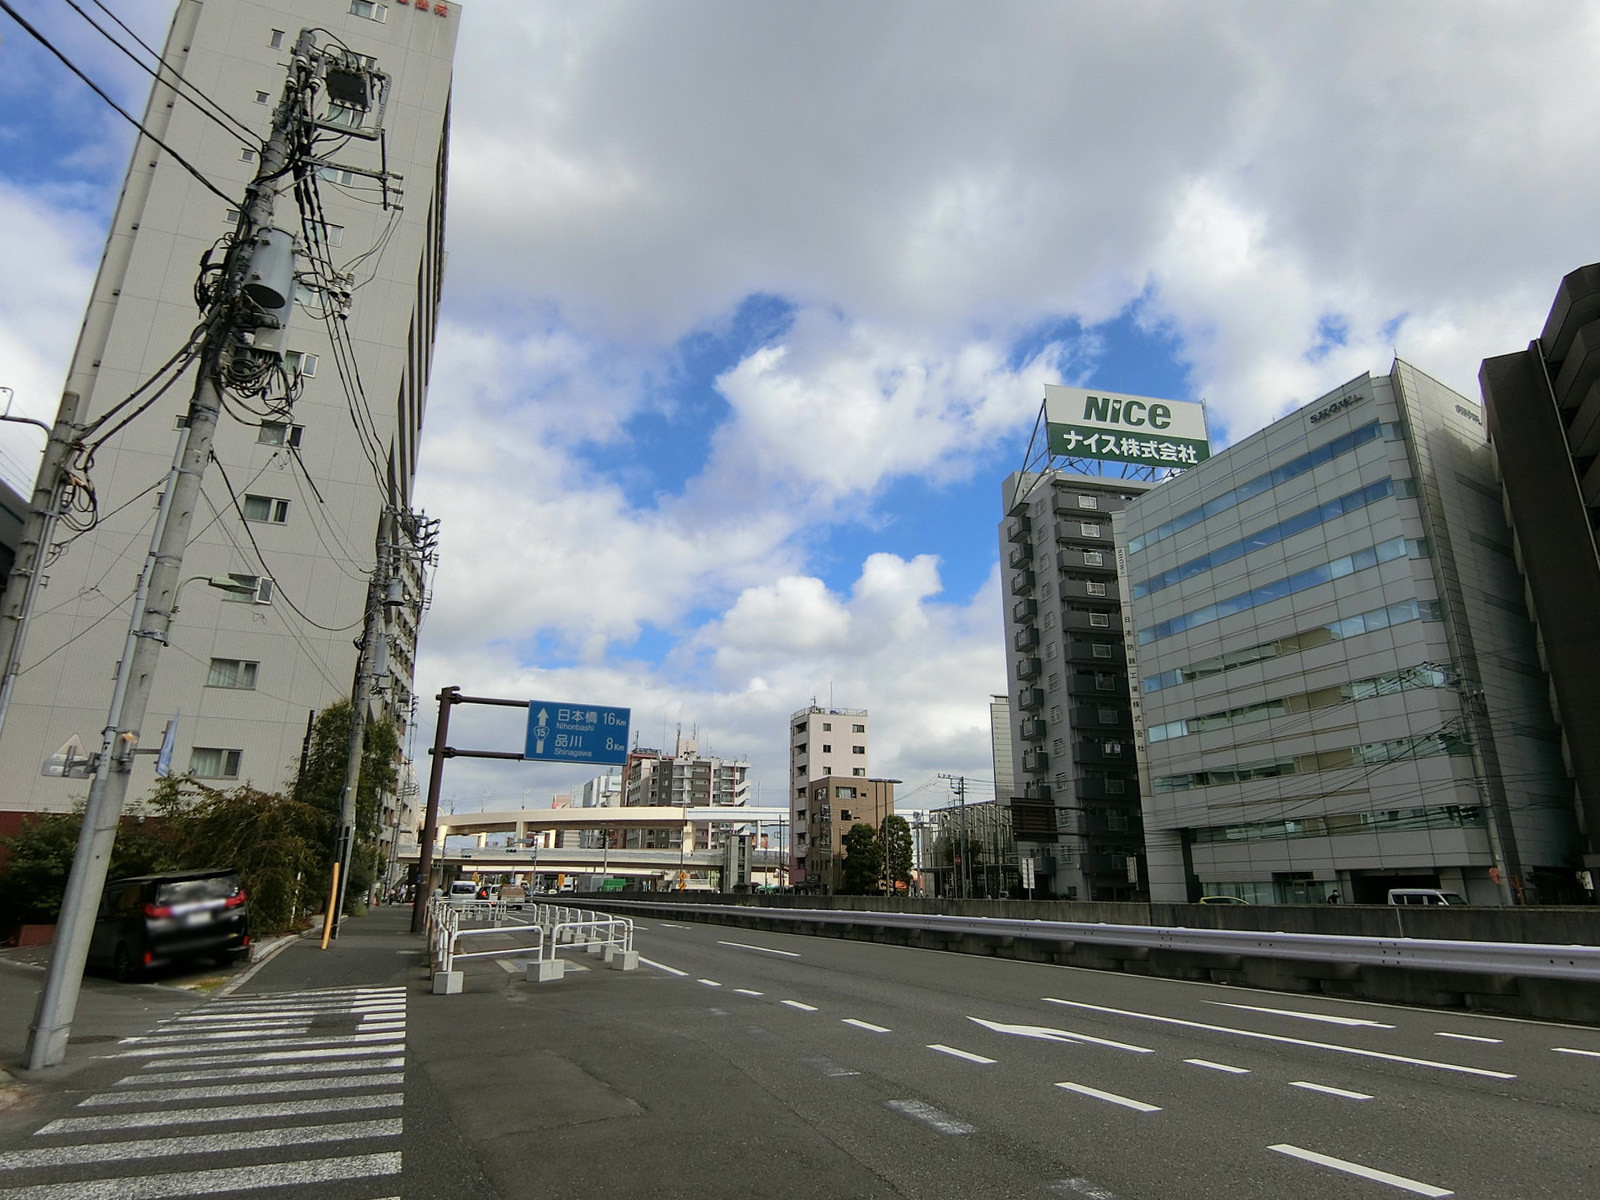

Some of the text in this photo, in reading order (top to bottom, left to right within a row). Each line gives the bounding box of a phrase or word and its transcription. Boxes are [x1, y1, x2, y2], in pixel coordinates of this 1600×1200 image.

[1083, 395, 1171, 429] Nice
[1063, 430, 1198, 464] ナイス株式会社
[558, 708, 598, 724] 日本橋
[536, 728, 546, 737] 15
[556, 722, 594, 732] Nihonbashi
[555, 734, 582, 748] 品川
[554, 748, 592, 758] Shinagawa
